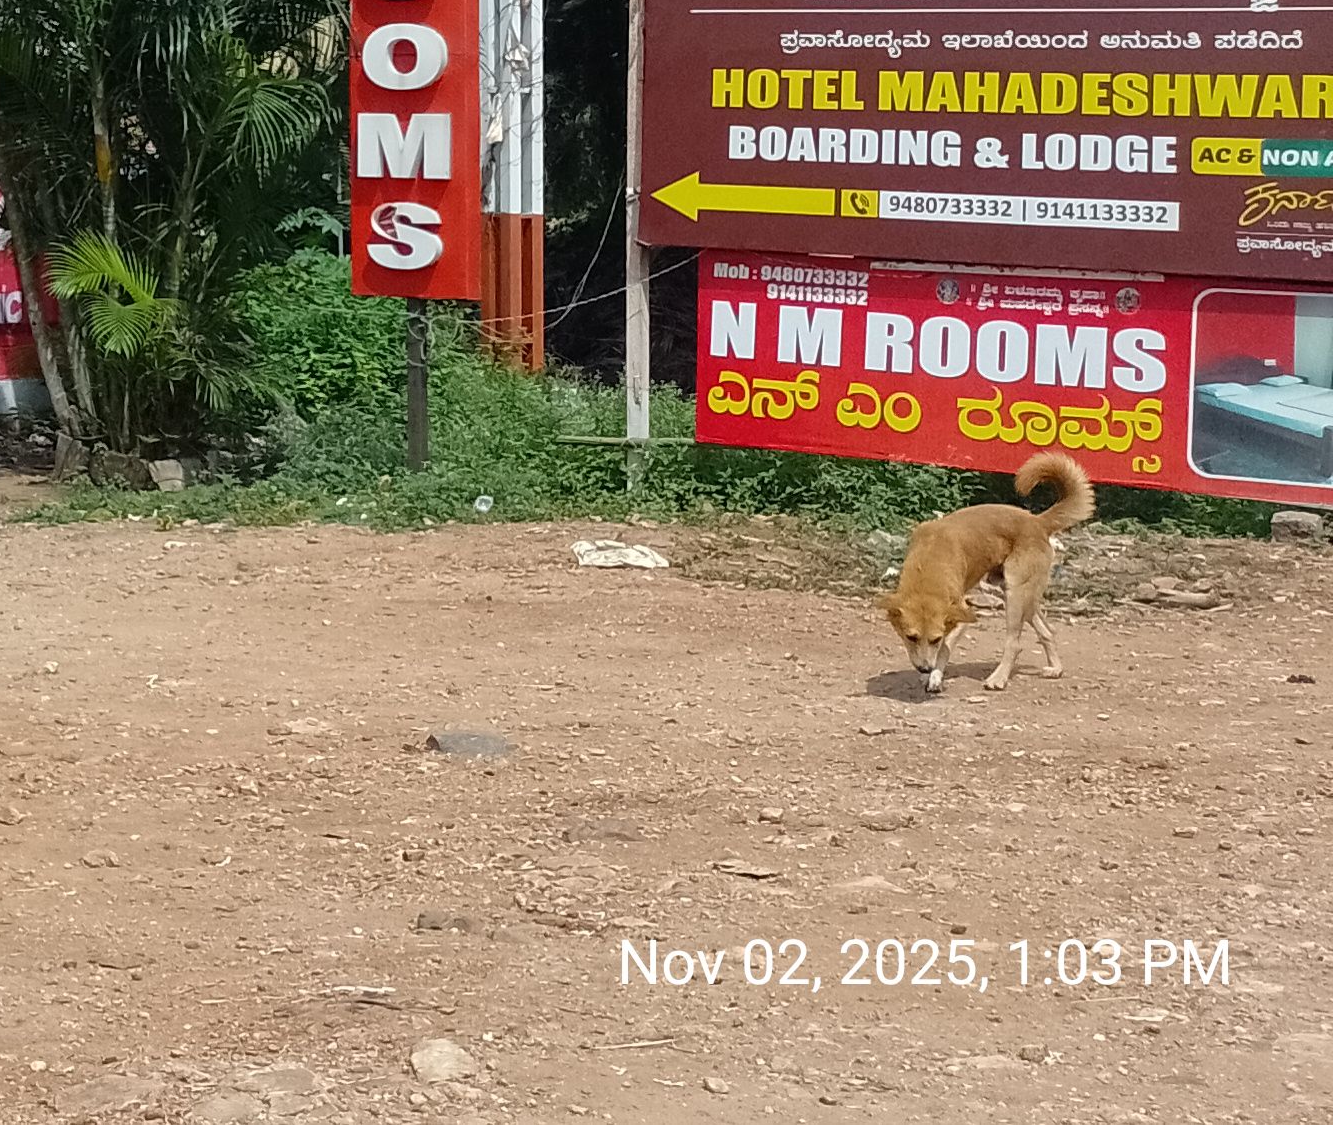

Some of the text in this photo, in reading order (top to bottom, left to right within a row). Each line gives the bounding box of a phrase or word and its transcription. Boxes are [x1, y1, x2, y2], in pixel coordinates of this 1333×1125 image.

[779, 28, 1304, 58] ಪ್ರವಾಸೋದ್ಯಮ ಇಲಾಖೆಯಿಂದ ಅನುಮತಿ ಪಡೆದಿದೆ
[711, 68, 865, 111] HOTEL
[728, 124, 1178, 174] BOARDING & LODGE
[1198, 147, 1232, 164] AC
[1236, 148, 1257, 164] &
[1261, 148, 1319, 167] NON
[888, 194, 1170, 224] 9480733332 9141133332
[713, 261, 750, 280] Mob
[760, 264, 870, 288] 9480733332
[766, 283, 869, 306] 9141133332
[709, 299, 1167, 393] N M ROOMS
[956, 385, 1163, 474] ರೂಮ್ಸ್
